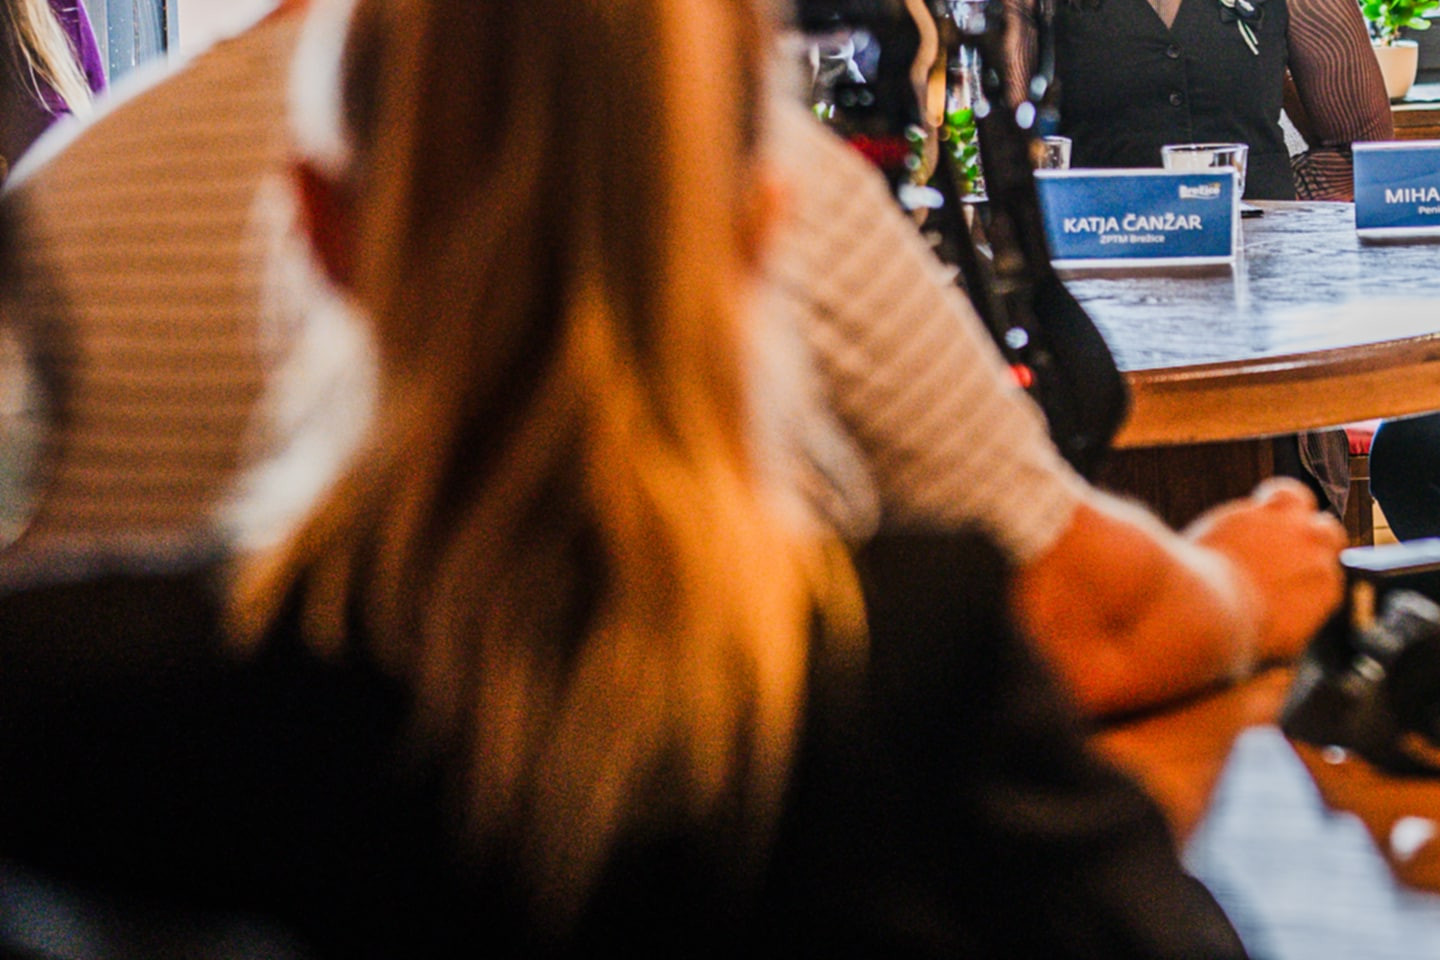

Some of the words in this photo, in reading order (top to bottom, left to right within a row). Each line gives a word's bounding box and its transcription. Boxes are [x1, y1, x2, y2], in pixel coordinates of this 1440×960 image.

[1384, 186, 1440, 204] MIHA
[1063, 216, 1120, 235] KATJA
[1122, 212, 1203, 231] ČANŽAR
